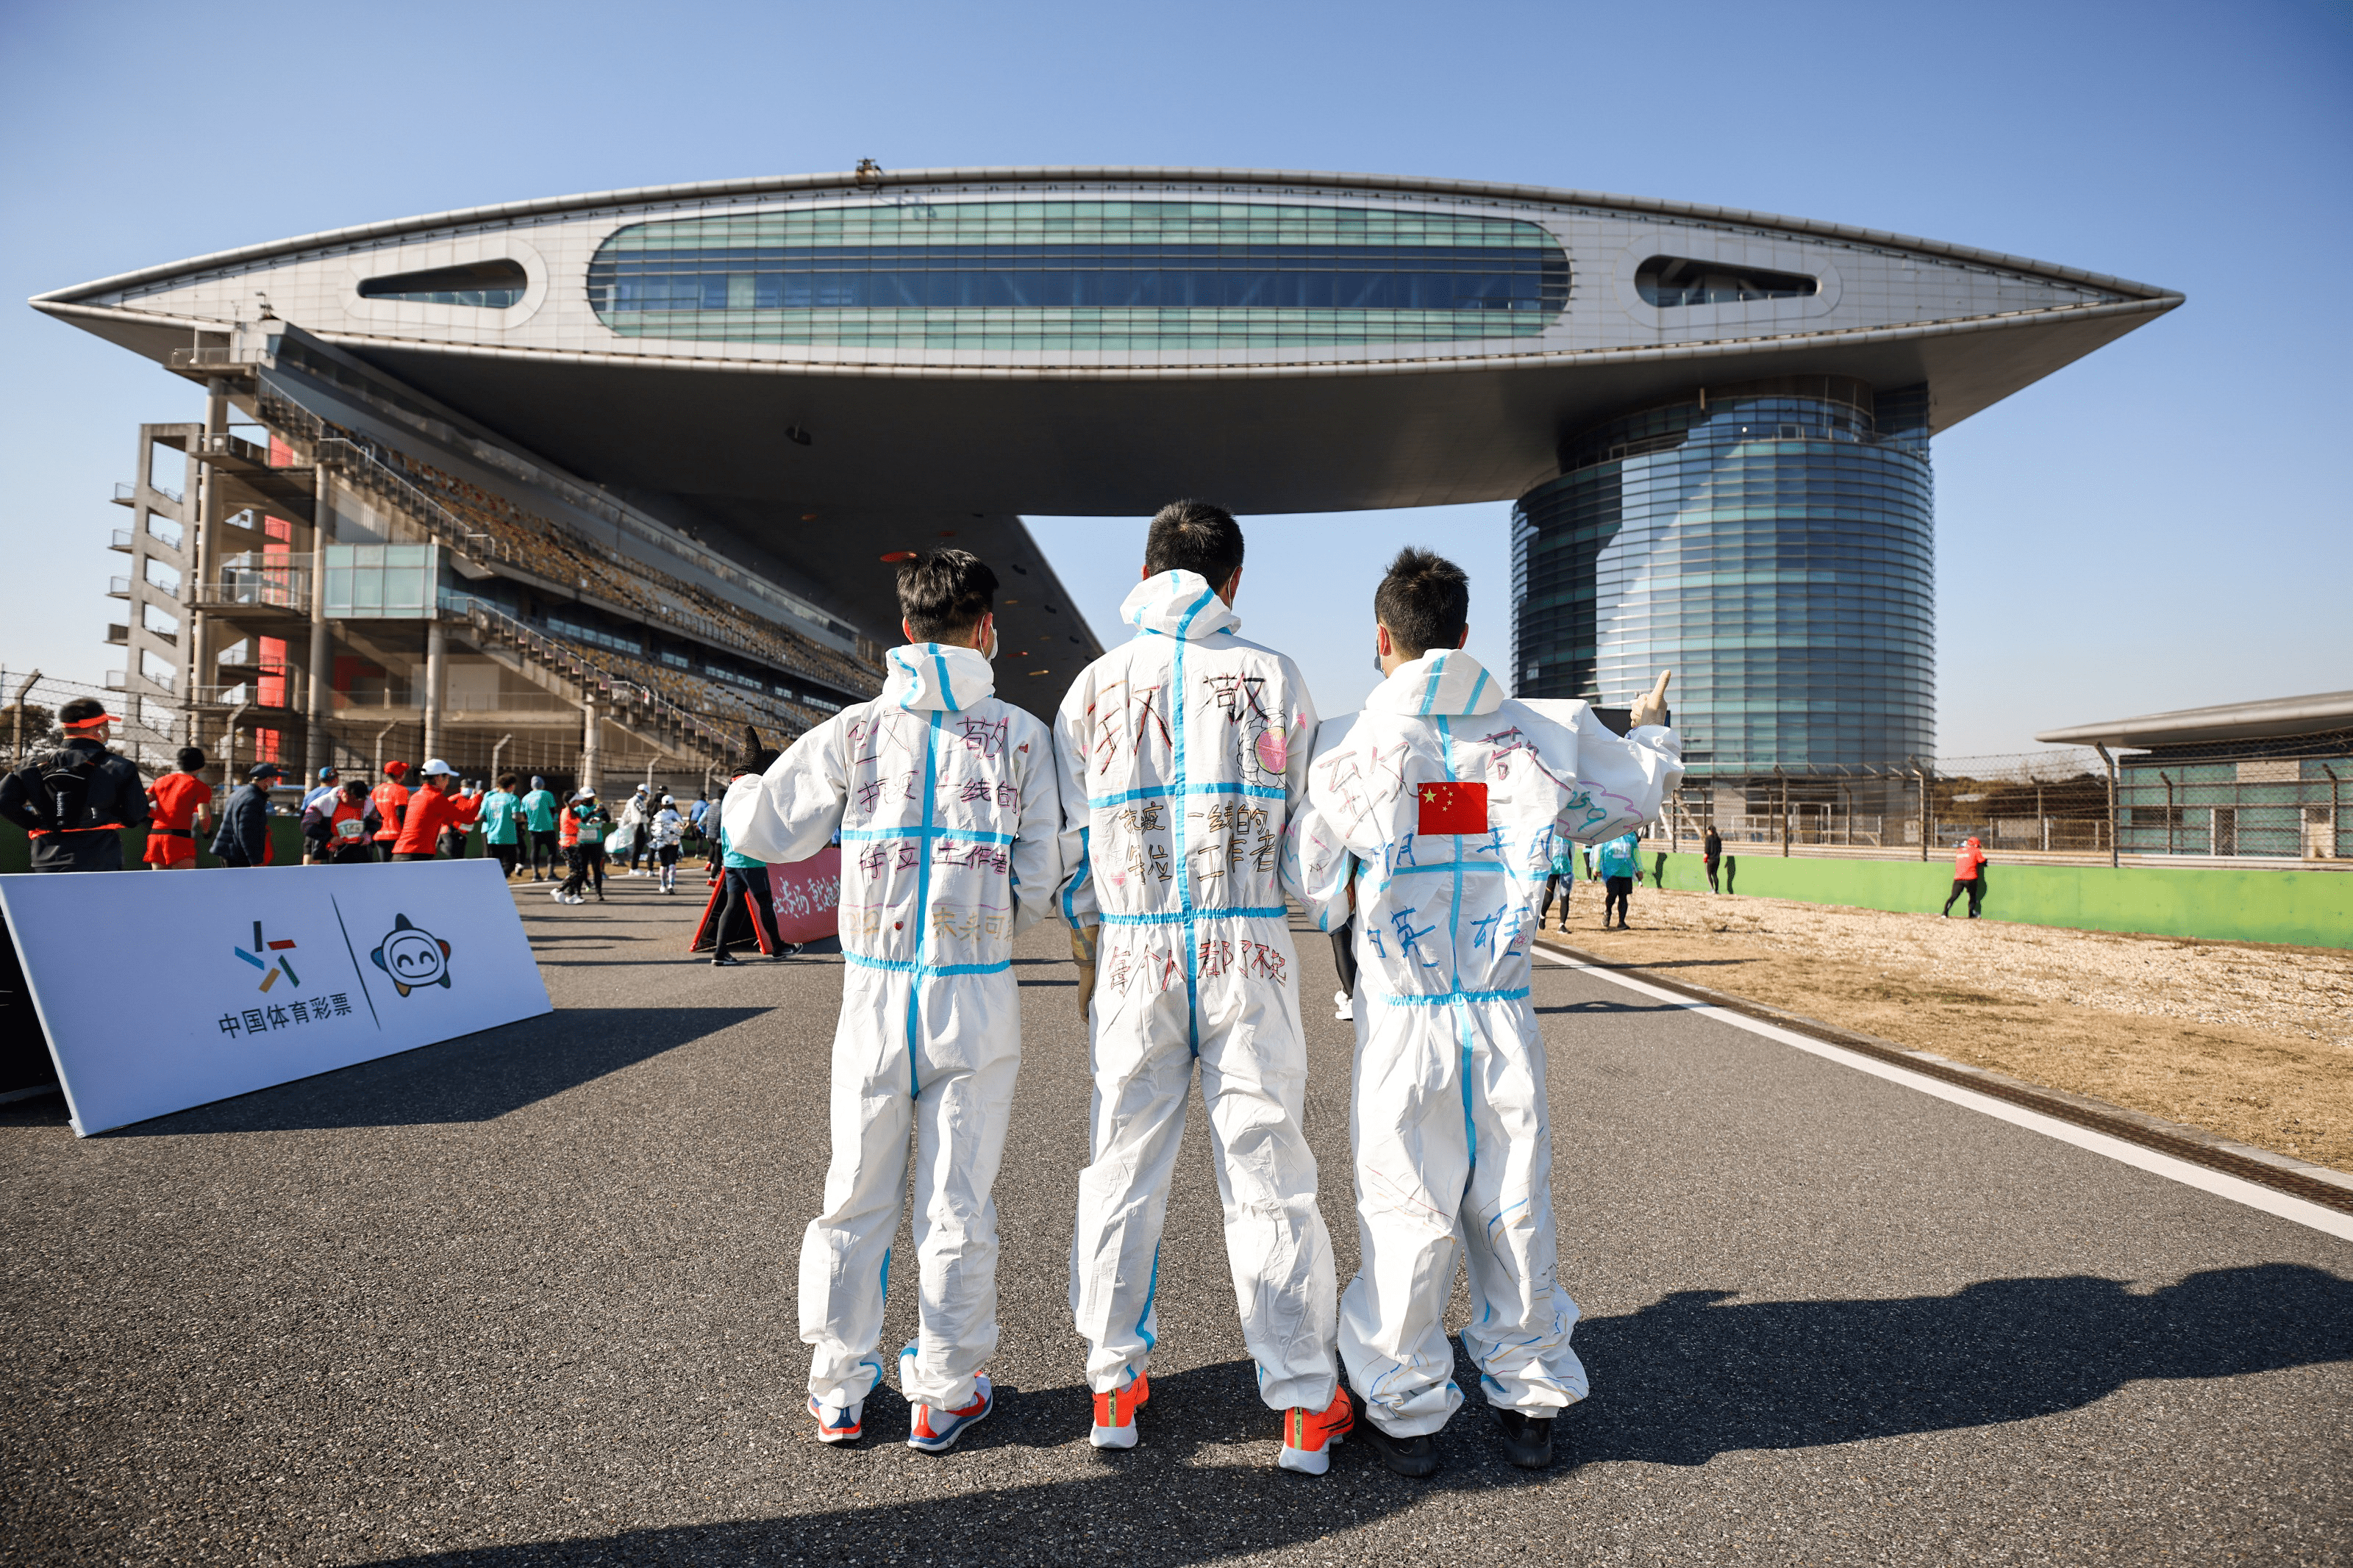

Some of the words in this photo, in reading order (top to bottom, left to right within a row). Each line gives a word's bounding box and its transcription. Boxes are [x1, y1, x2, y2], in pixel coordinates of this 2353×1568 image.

[1128, 828, 1277, 886] 每位工作者
[932, 906, 1013, 945] 未来可
[218, 992, 352, 1039] 中国体育彩票
